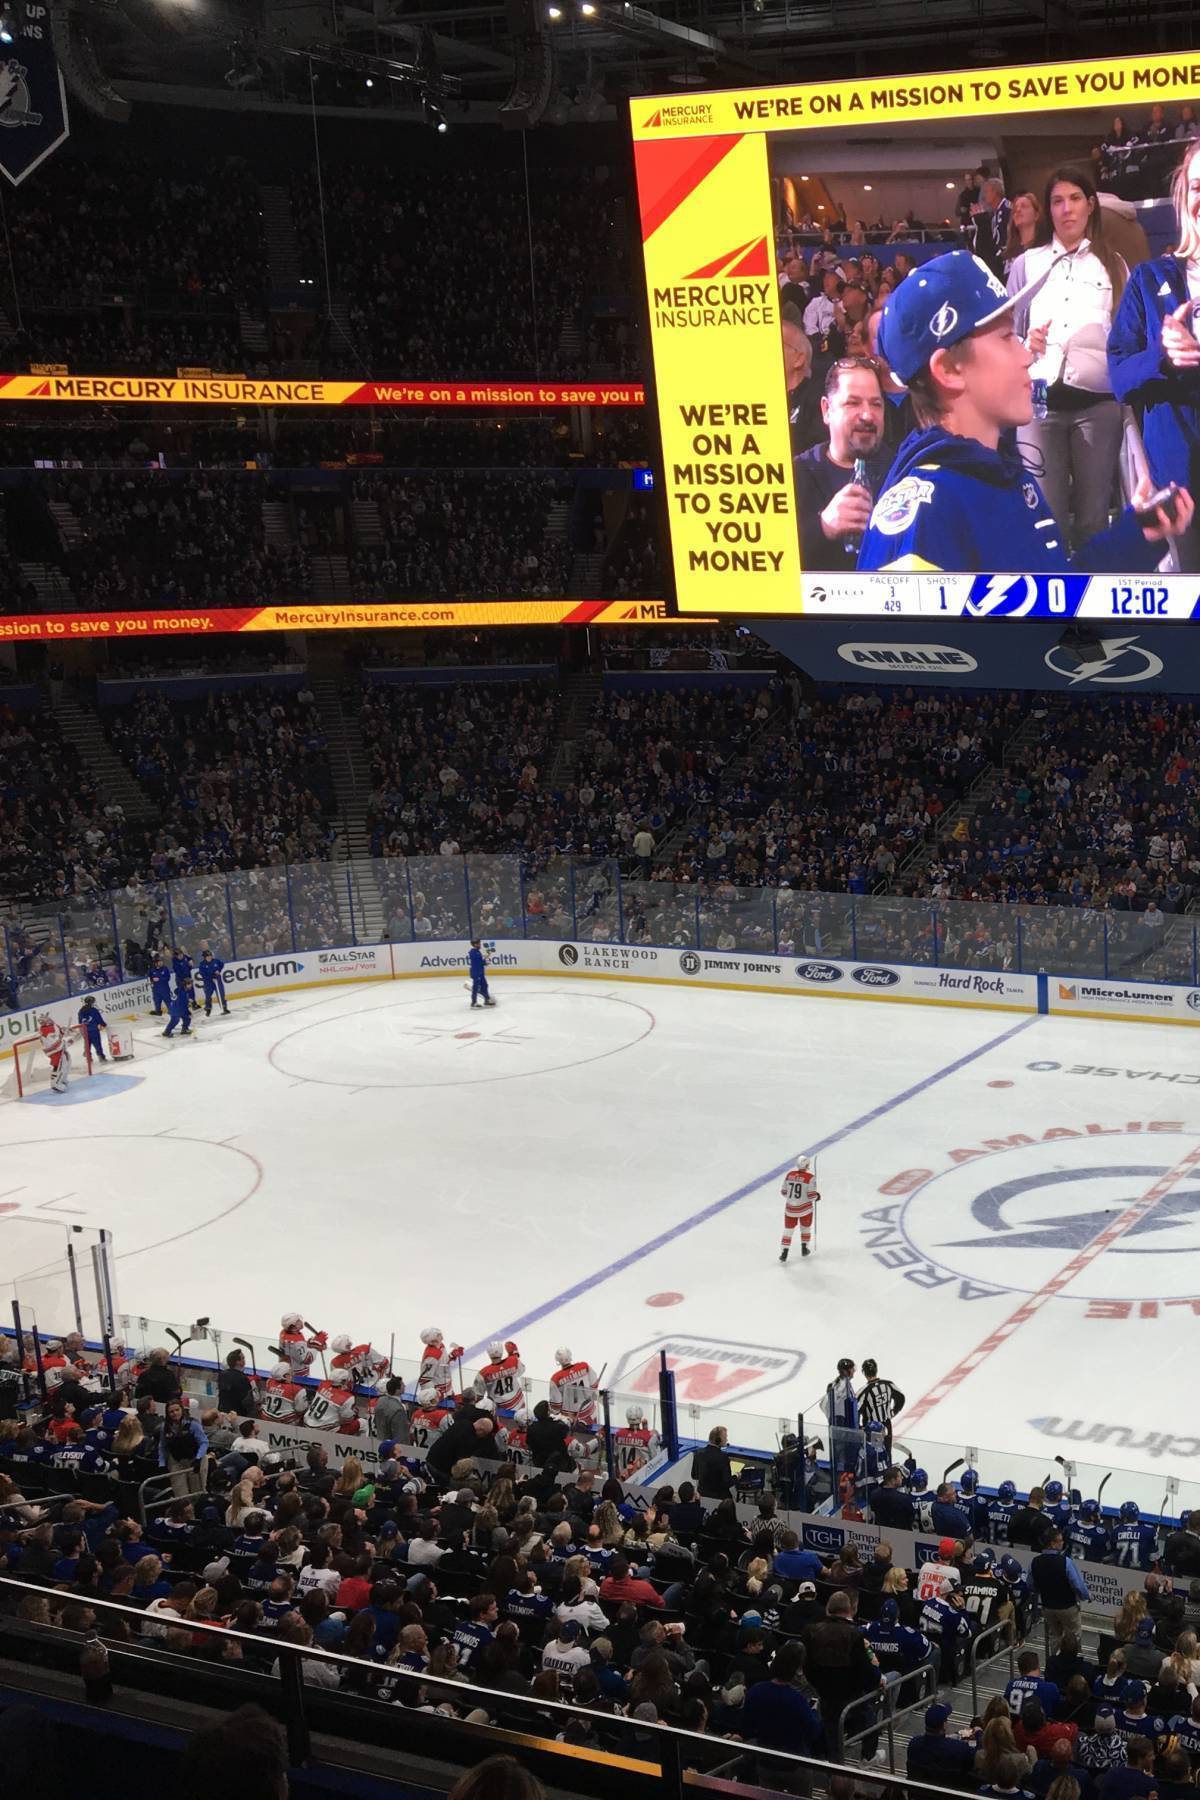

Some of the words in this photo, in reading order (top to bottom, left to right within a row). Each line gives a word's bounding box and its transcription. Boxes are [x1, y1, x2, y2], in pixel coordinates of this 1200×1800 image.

[734, 97, 803, 120] WE'RE
[809, 95, 842, 114] ON
[848, 92, 864, 111] A
[871, 84, 964, 109] MISSION
[970, 80, 1002, 102] TO
[1008, 74, 1069, 98] SAVE
[1075, 71, 1126, 93] YOU
[662, 104, 712, 117] MERCURY
[662, 114, 714, 126] INSURANCE
[654, 283, 770, 308] MERCURY
[655, 306, 775, 328] INSURANCE
[55, 380, 176, 398] MERCURY
[184, 382, 325, 401] INSURANCE
[374, 386, 424, 401] We're
[430, 390, 450, 401] on
[456, 390, 466, 401] a
[471, 387, 533, 402] mission
[539, 388, 556, 402] to
[561, 391, 596, 403] save
[601, 391, 630, 406] you
[679, 403, 768, 426] WE'RE
[692, 433, 733, 456] ON
[741, 433, 761, 455] A
[673, 463, 785, 485] MISSION
[675, 492, 711, 514] TO
[719, 492, 789, 514] SAVE
[705, 521, 762, 544] YOU
[689, 550, 784, 572] MONEY
[870, 577, 910, 585] FACEOFF
[927, 577, 958, 585] SHOTS
[890, 586, 896, 598] 3
[939, 586, 948, 610] 1
[1048, 578, 1067, 613] 0
[1111, 587, 1169, 615] 12:02
[275, 607, 455, 625] MercuryInsurance.com
[46, 621, 65, 634] to
[70, 621, 110, 634] save
[114, 621, 147, 635] you
[153, 617, 214, 632] money.
[851, 649, 969, 666] AMALIE
[584, 946, 658, 960] LAKEWOOD
[584, 957, 629, 969] RANCH
[704, 959, 741, 971] JIMMY
[743, 961, 782, 975] JOHN'S
[804, 963, 835, 981] Ford
[195, 960, 297, 989] Sectrum
[860, 967, 892, 985] Ford
[938, 973, 970, 990] Hard
[973, 977, 1005, 995] Rock
[1081, 986, 1174, 1002] MicroLumen
[105, 999, 135, 1013] South
[946, 1120, 1186, 1164] AMALIE
[788, 1182, 803, 1199] 79
[859, 1203, 1012, 1301] ARENA
[493, 1376, 514, 1397] 48
[311, 1395, 329, 1419] 49
[809, 1529, 842, 1546] TGH
[847, 1530, 881, 1544] Tampa
[1117, 1531, 1141, 1541] CIRELLI
[1116, 1541, 1142, 1568] 71
[1081, 1571, 1118, 1586] Tampa
[965, 1584, 998, 1597] STAMKOS
